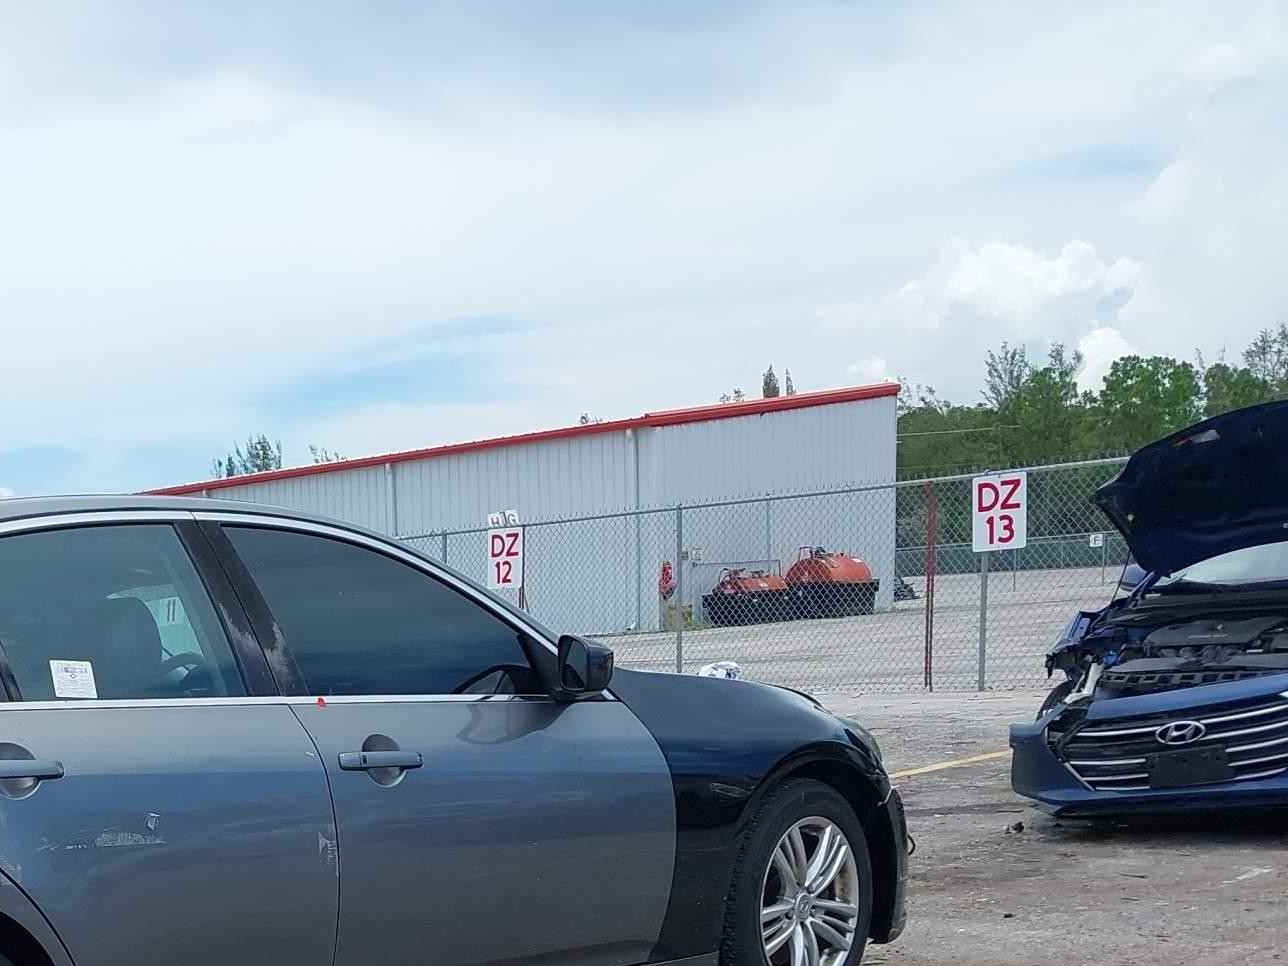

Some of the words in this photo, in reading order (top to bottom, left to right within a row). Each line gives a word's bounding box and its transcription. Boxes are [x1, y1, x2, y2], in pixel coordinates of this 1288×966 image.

[978, 478, 1021, 513] DZ
[986, 514, 1015, 545] 13
[491, 532, 519, 558] DZ
[494, 560, 512, 584] 12
